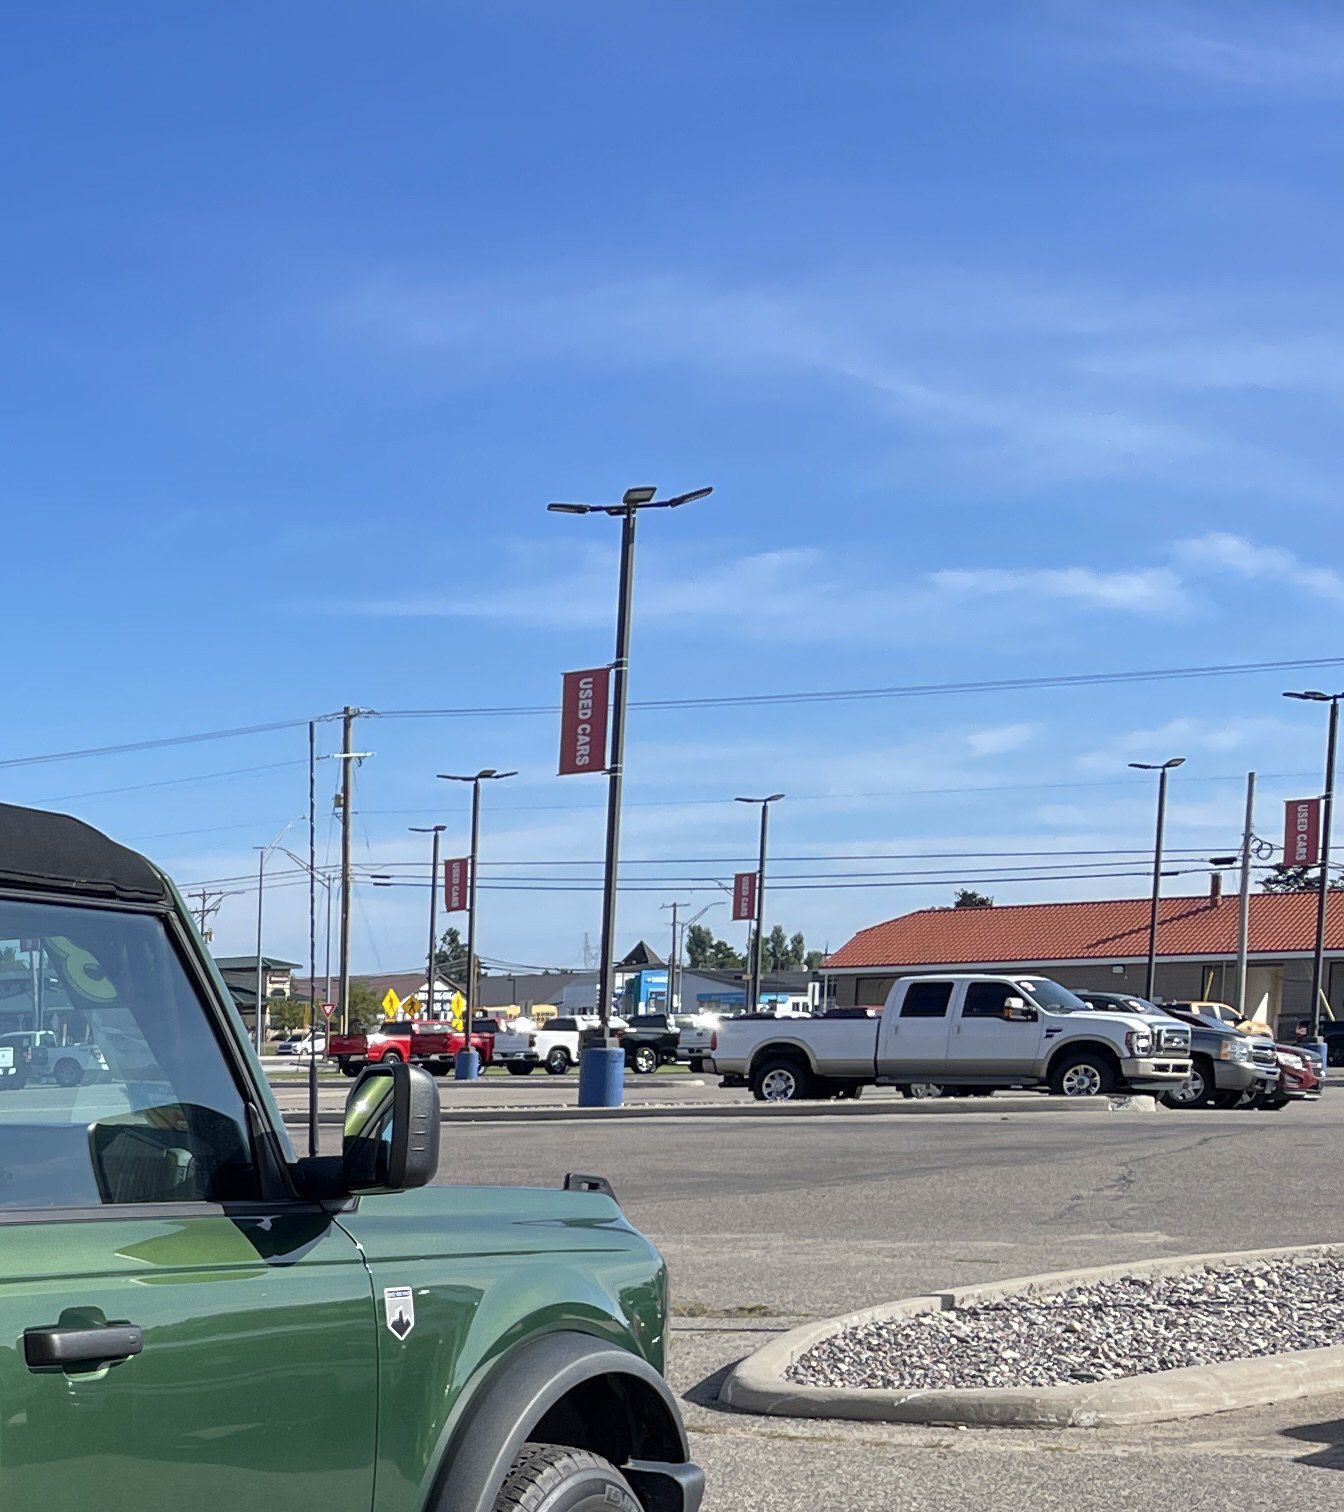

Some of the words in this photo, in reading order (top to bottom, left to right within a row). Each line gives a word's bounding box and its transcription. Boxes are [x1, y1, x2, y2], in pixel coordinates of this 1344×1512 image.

[577, 677, 594, 720] USED
[575, 723, 591, 766] CARS
[1296, 804, 1309, 832] USED
[1295, 833, 1308, 861] CARS
[451, 862, 461, 885] USED
